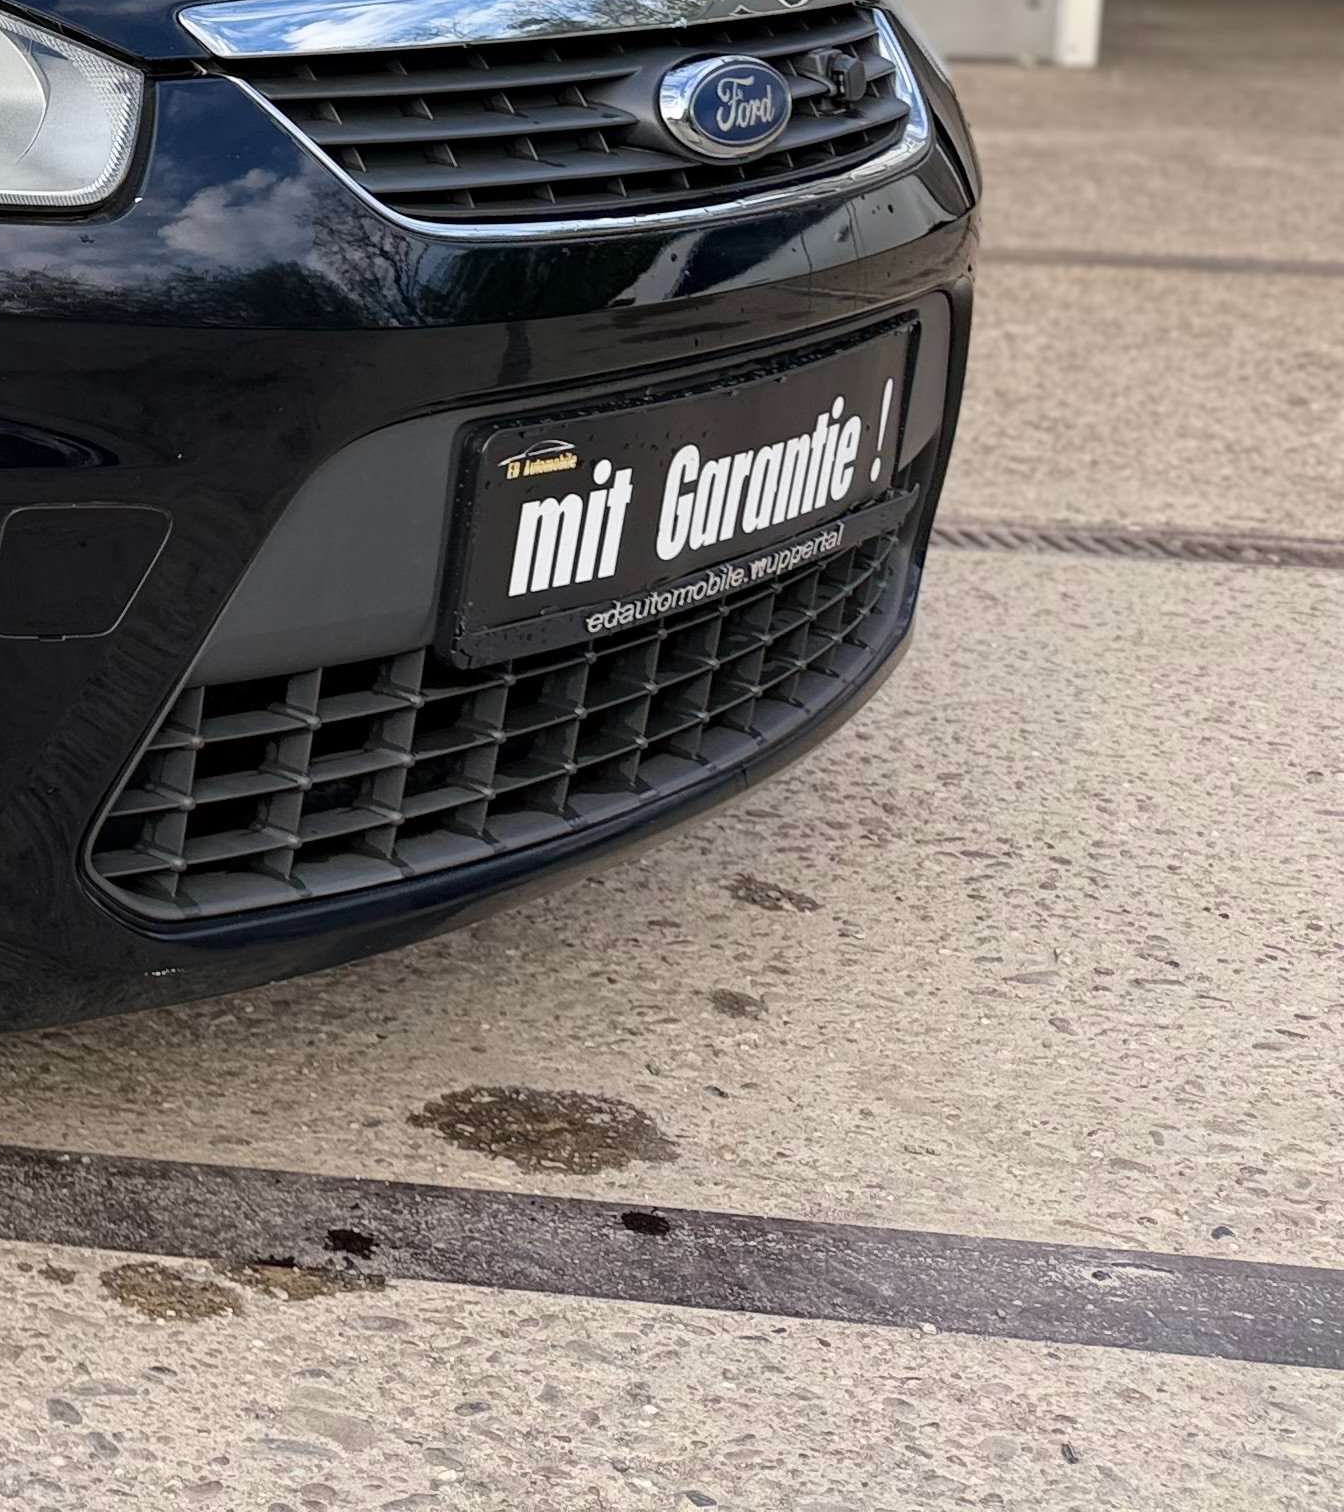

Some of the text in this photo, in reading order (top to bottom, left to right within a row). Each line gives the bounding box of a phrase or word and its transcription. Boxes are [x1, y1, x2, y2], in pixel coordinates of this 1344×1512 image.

[716, 75, 775, 132] Ford
[508, 459, 634, 597] mit
[655, 396, 862, 561] Garantie
[585, 520, 846, 634] edautomobile.wuppertal
